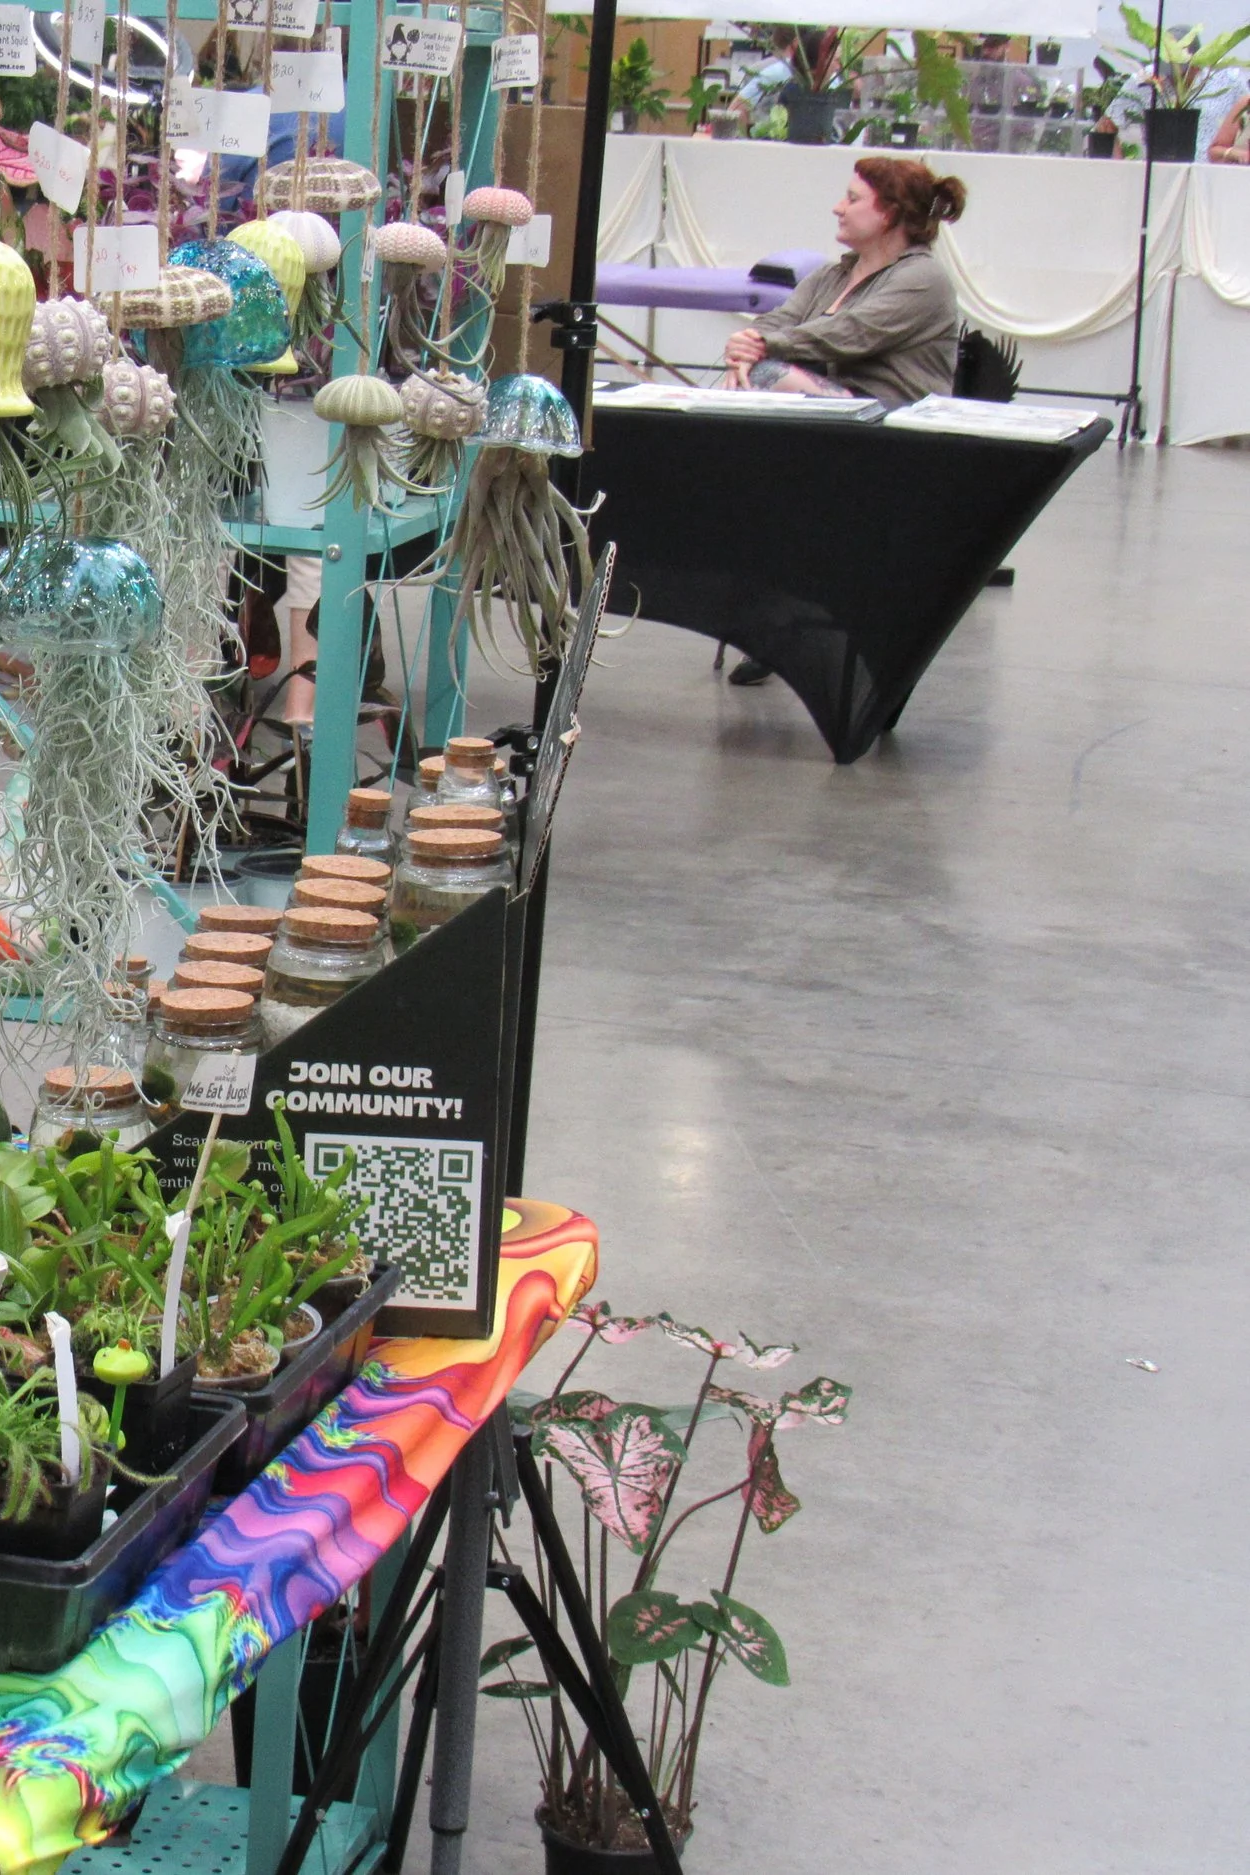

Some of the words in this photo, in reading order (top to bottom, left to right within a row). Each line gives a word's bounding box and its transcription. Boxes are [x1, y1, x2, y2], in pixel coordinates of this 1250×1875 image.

[11, 36, 28, 47] Squid
[221, 136, 240, 149] tax
[288, 1061, 361, 1086] JOIN
[368, 1065, 433, 1089] OUR
[186, 1081, 204, 1098] We
[206, 1083, 223, 1099] Eat
[265, 1089, 463, 1119] COMMUNITY!
